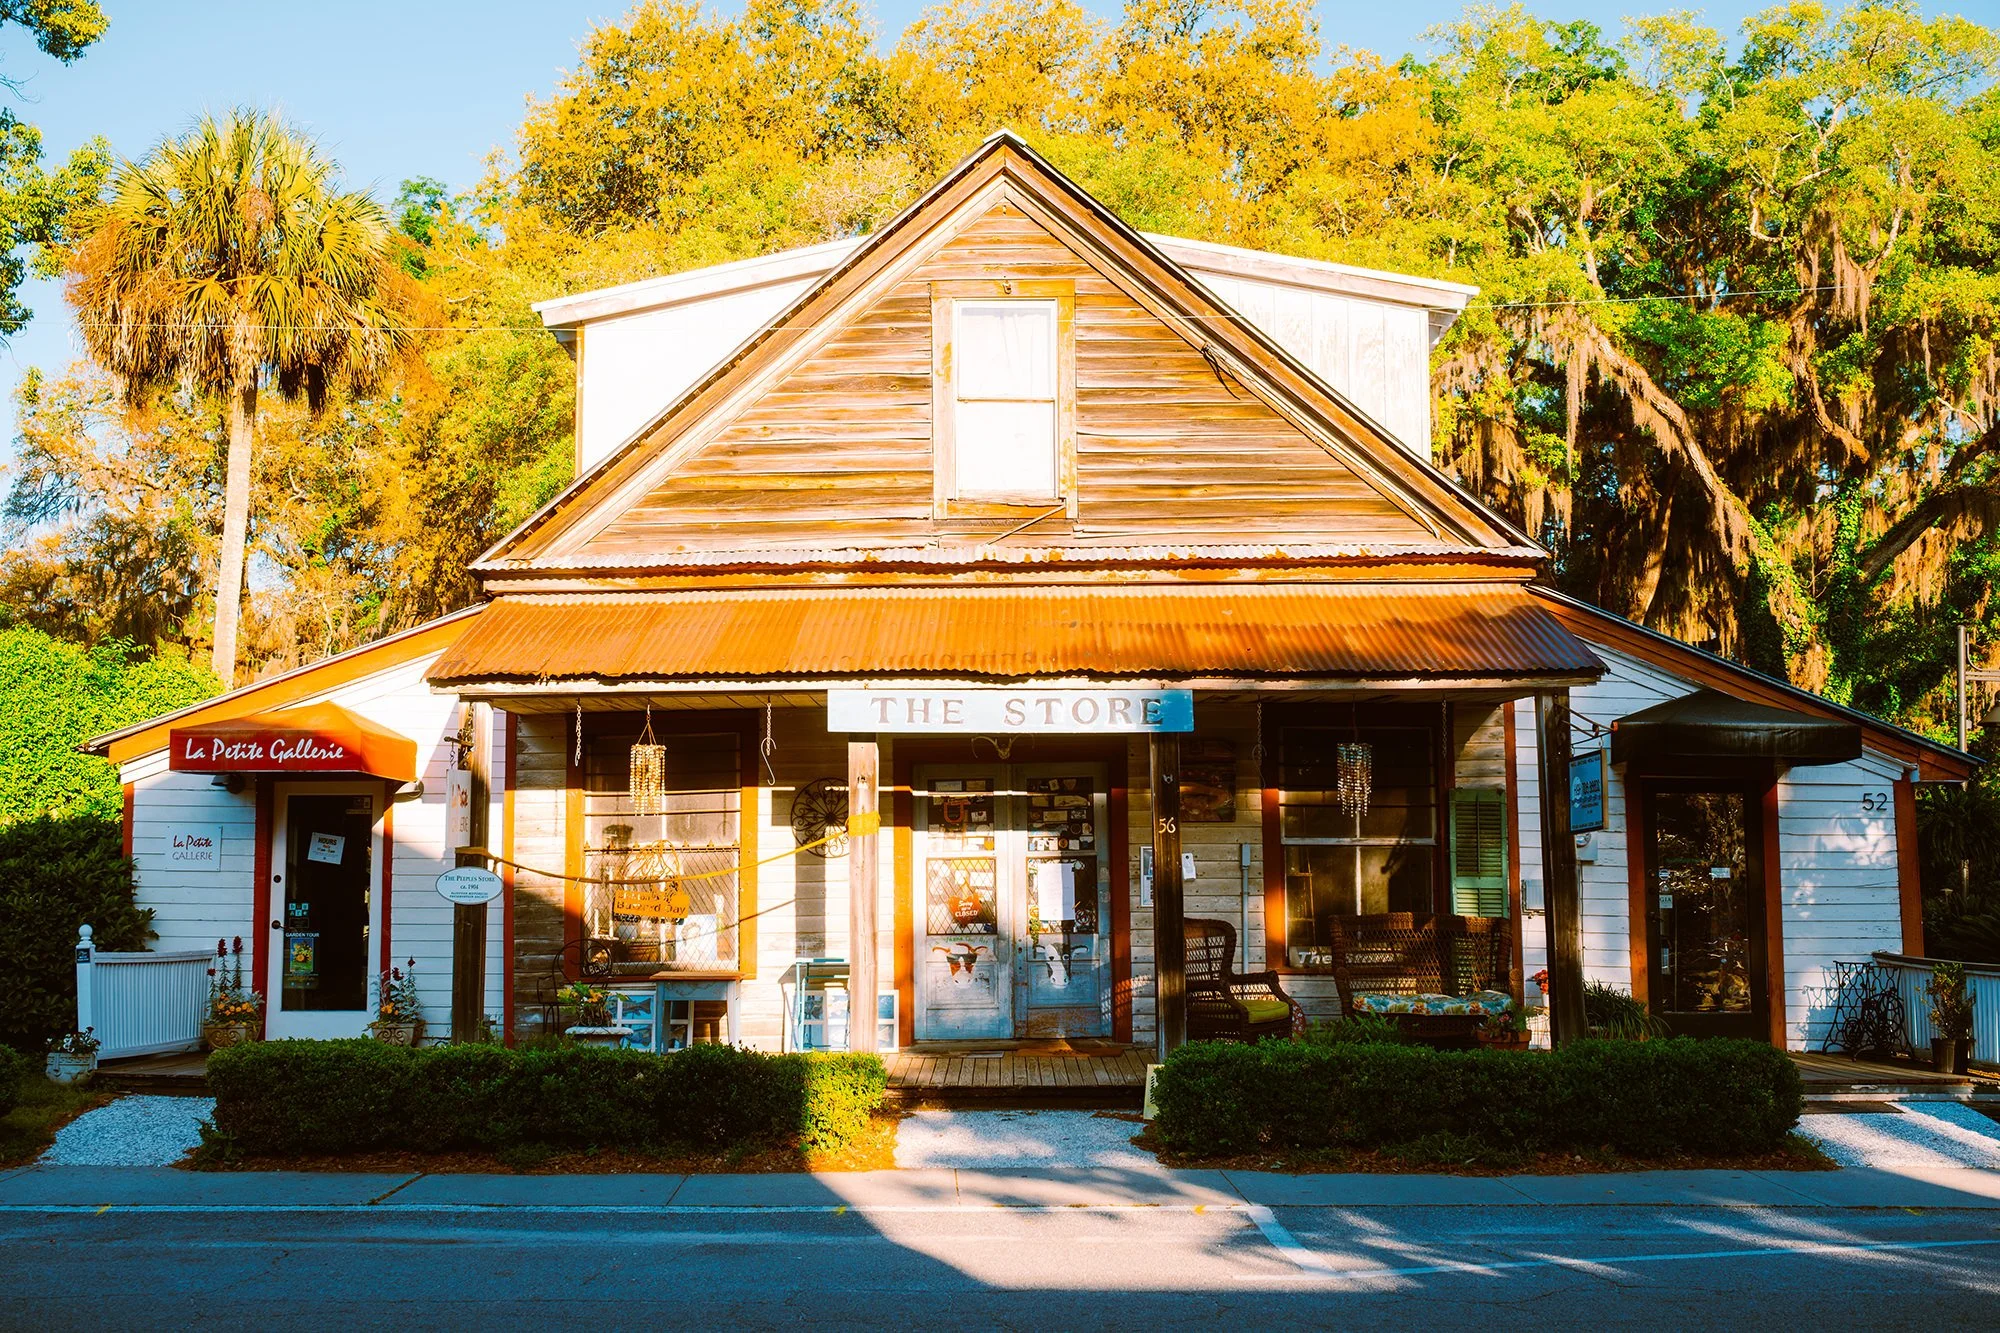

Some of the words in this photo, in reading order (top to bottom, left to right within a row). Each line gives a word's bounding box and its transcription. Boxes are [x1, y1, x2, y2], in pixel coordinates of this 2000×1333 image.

[870, 697, 964, 725] THE
[1003, 697, 1164, 726] STORE
[185, 737, 206, 760] La
[211, 737, 264, 762] Petite
[269, 738, 344, 764] Gallerie
[1862, 792, 1888, 811] 52
[1158, 816, 1176, 834] 56
[173, 834, 185, 848] La
[185, 834, 213, 851] Petite
[172, 851, 213, 861] GALLERIE
[1299, 951, 1332, 965] The
